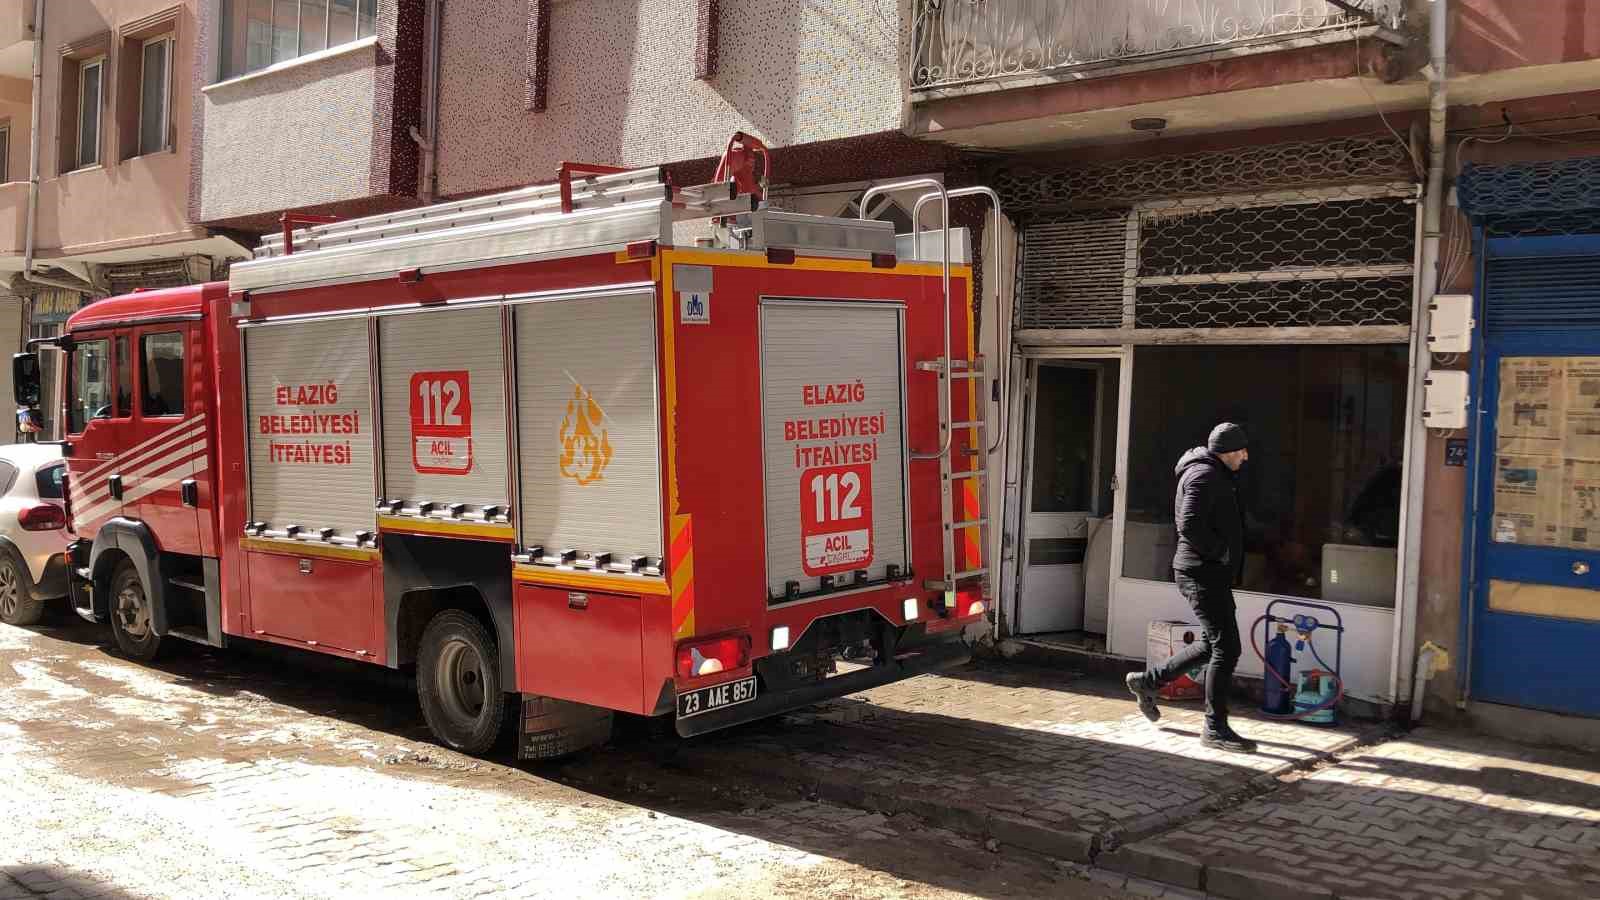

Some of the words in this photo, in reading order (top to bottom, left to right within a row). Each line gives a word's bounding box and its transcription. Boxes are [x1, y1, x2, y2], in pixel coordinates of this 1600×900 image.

[276, 380, 338, 405] ELAZIĞ
[419, 380, 462, 426] 112
[802, 379, 865, 405] ELAZIĞ
[259, 410, 359, 434] BELEDİYESİ
[784, 412, 886, 441] BELEDİYESİ
[269, 440, 351, 464] İTFAİYESİ
[795, 438, 878, 468] İTFAİYESİ
[811, 471, 862, 523] 112
[685, 692, 700, 714] 23
[707, 685, 729, 708] AAE
[733, 679, 754, 701] 857
